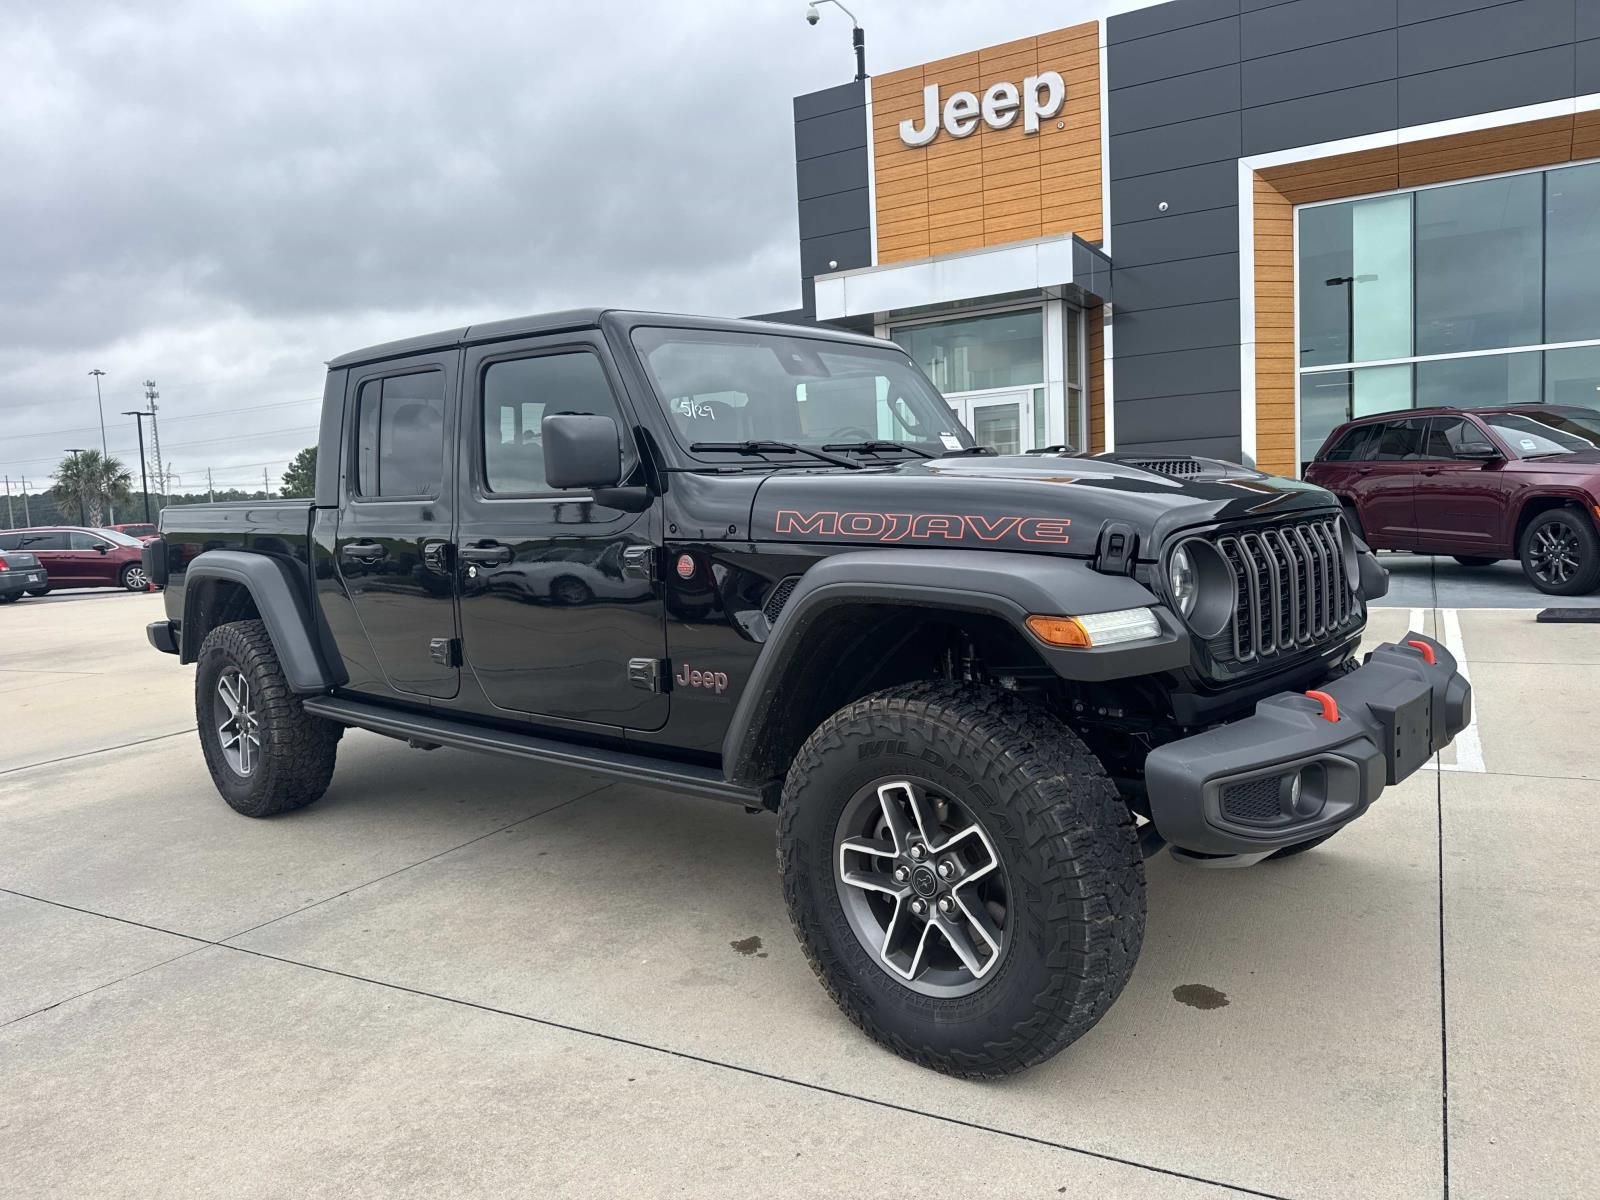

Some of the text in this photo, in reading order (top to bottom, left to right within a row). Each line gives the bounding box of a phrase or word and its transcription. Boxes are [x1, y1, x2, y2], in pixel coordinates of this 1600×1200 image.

[899, 70, 1066, 148] Jeep
[679, 399, 715, 421] 5/29
[775, 510, 1072, 544] MOJAVE
[676, 664, 729, 694] Jeep
